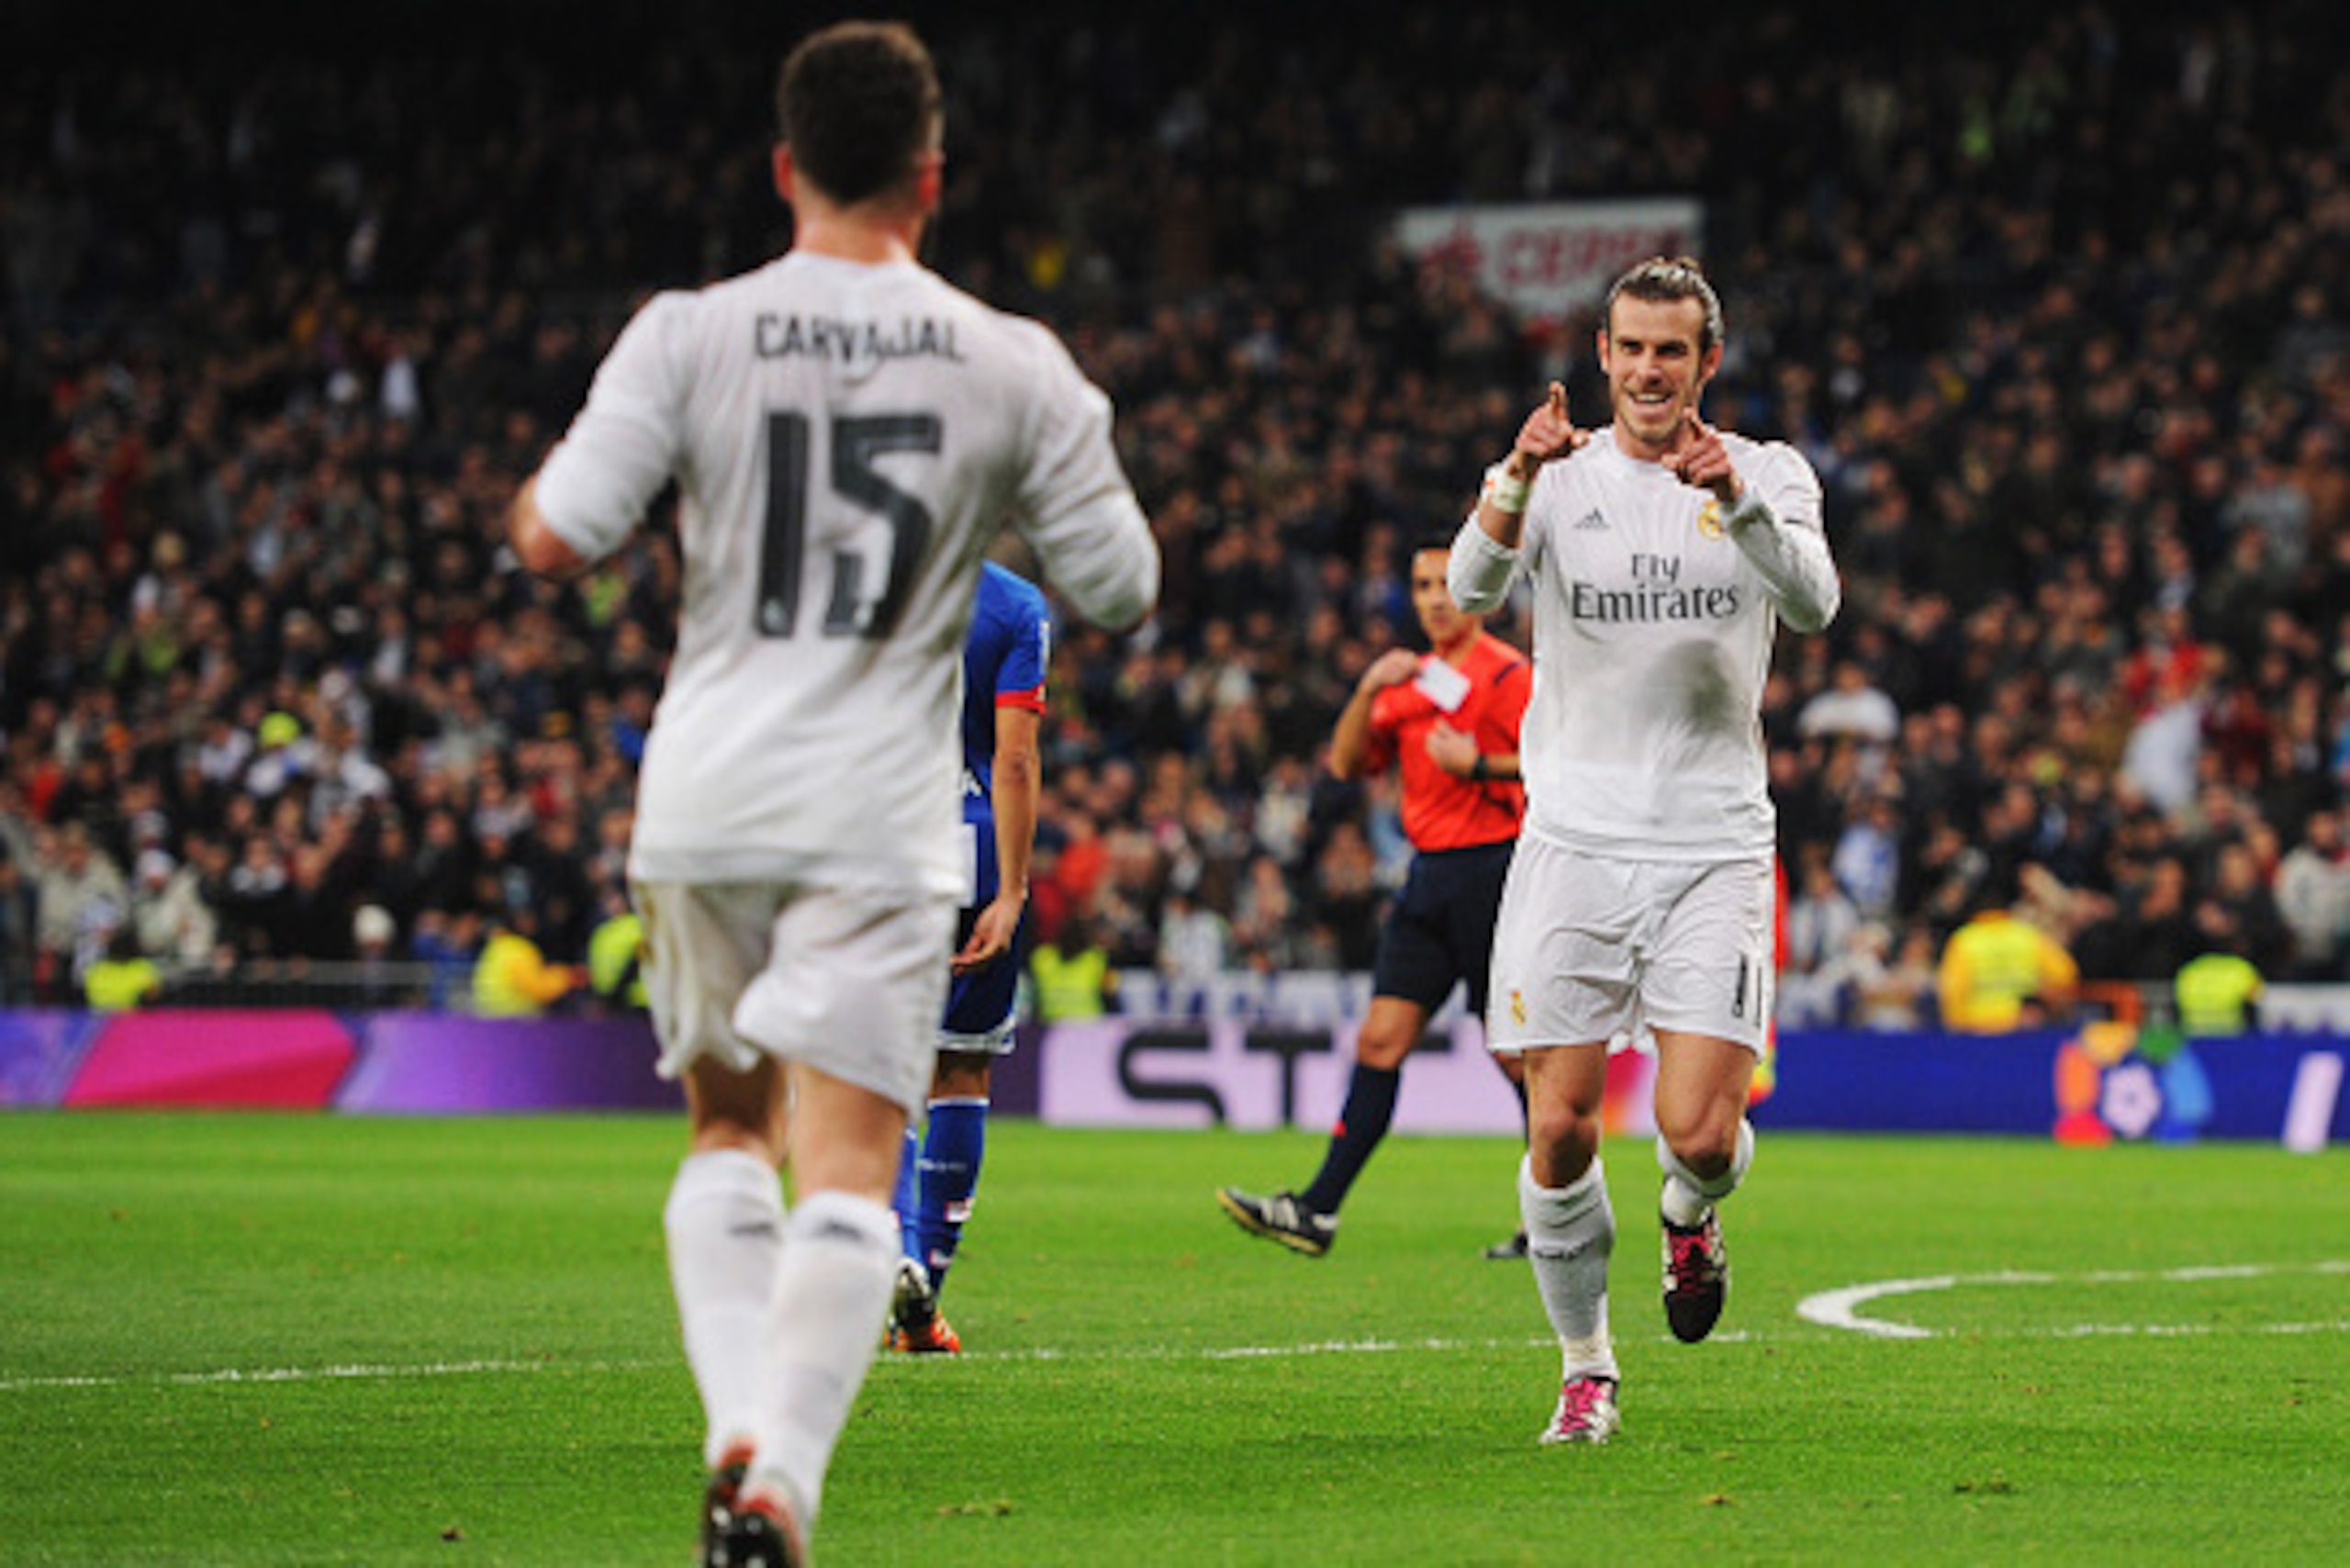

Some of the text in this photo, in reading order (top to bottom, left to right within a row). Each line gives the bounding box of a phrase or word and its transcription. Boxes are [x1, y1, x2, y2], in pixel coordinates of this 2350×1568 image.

[754, 313, 967, 363] CARVAJAL
[755, 412, 942, 637] 15
[1630, 554, 1680, 583] Fly
[1572, 584, 1740, 622] Emirates
